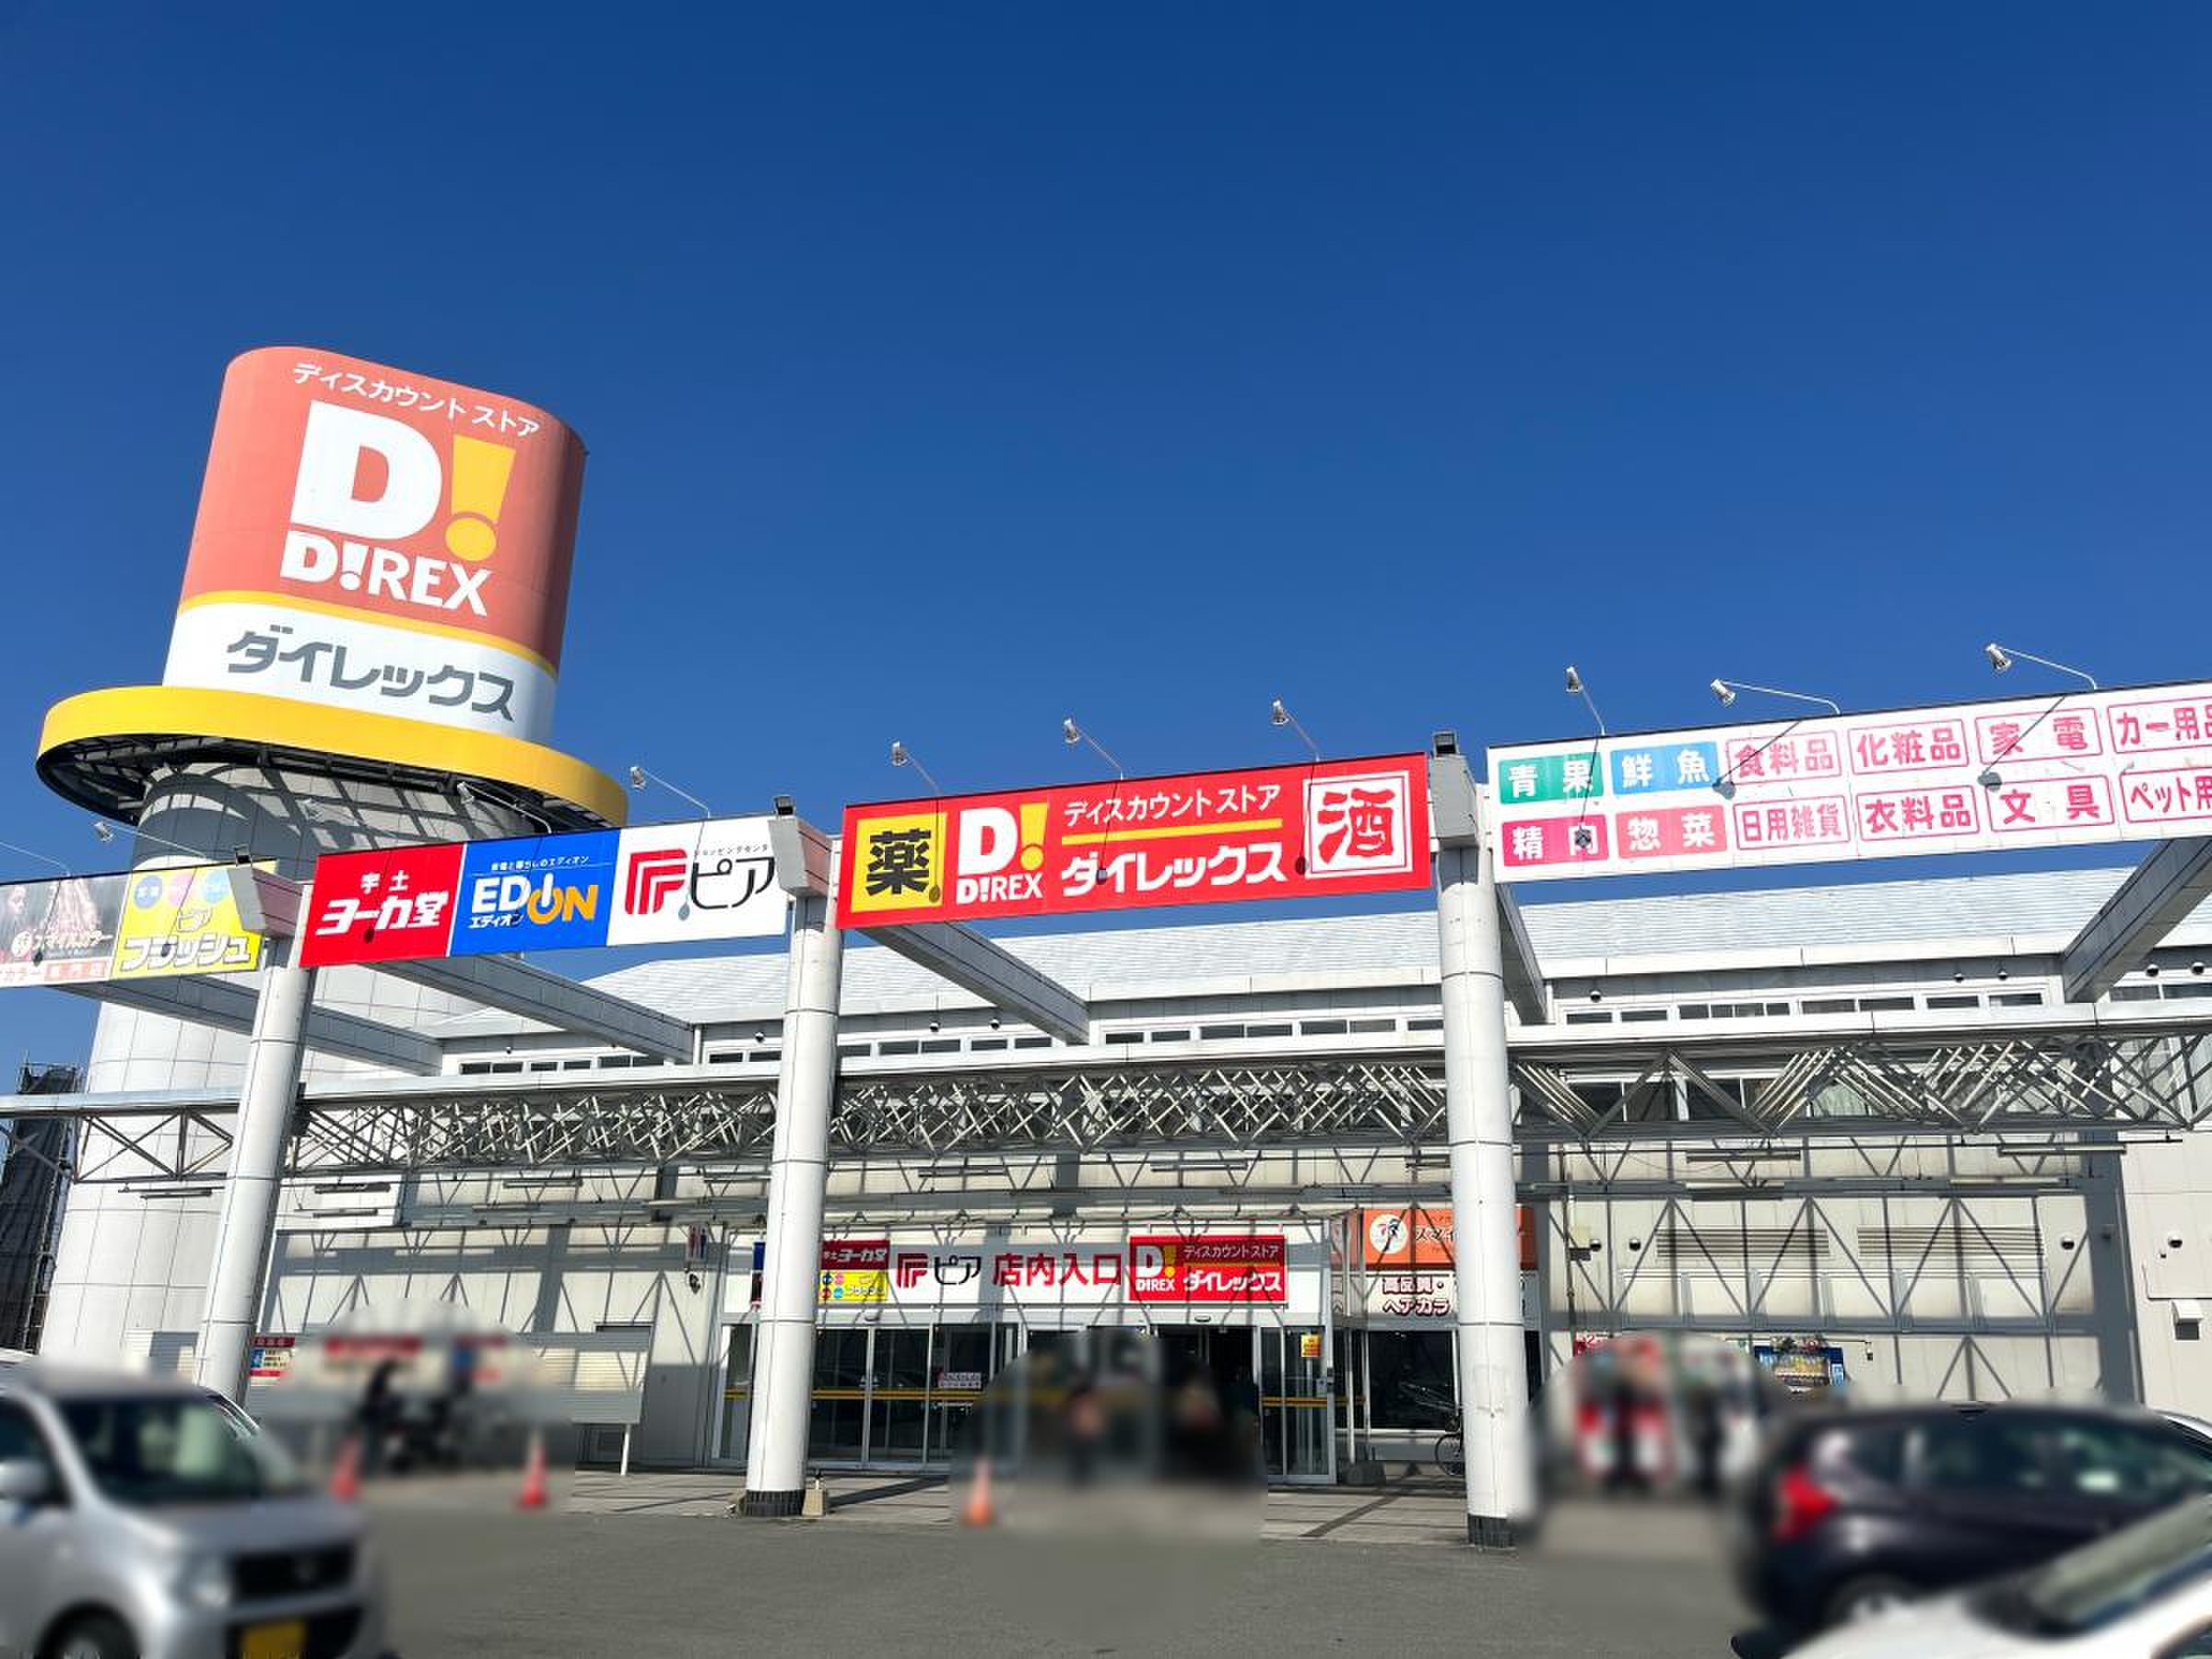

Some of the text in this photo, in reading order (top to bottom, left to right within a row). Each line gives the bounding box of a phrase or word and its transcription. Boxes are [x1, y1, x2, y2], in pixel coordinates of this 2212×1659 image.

[226, 624, 516, 723] ダイレックス
[1507, 758, 1594, 800] 青果
[1620, 748, 1712, 788] 鮮魚
[1735, 738, 1836, 779] 食料品
[1856, 726, 1962, 768] 化粧品
[1989, 715, 2089, 756] 家電
[1317, 787, 1397, 865] 酒
[1627, 811, 1719, 853] 惣菜
[1741, 802, 1844, 843] 日用雑貨
[1865, 793, 1972, 834] 衣料品
[1999, 783, 2100, 825] 文具
[690, 856, 776, 911] ピア
[865, 827, 932, 897] 薬
[1061, 841, 1288, 898] ダイレックス
[314, 890, 450, 936] ヨーカ堂
[468, 912, 524, 929] エディオン
[471, 872, 599, 925] EDION
[934, 1253, 1123, 1288] ピア 店内入口
[1182, 1269, 1283, 1292] ダイレックス
